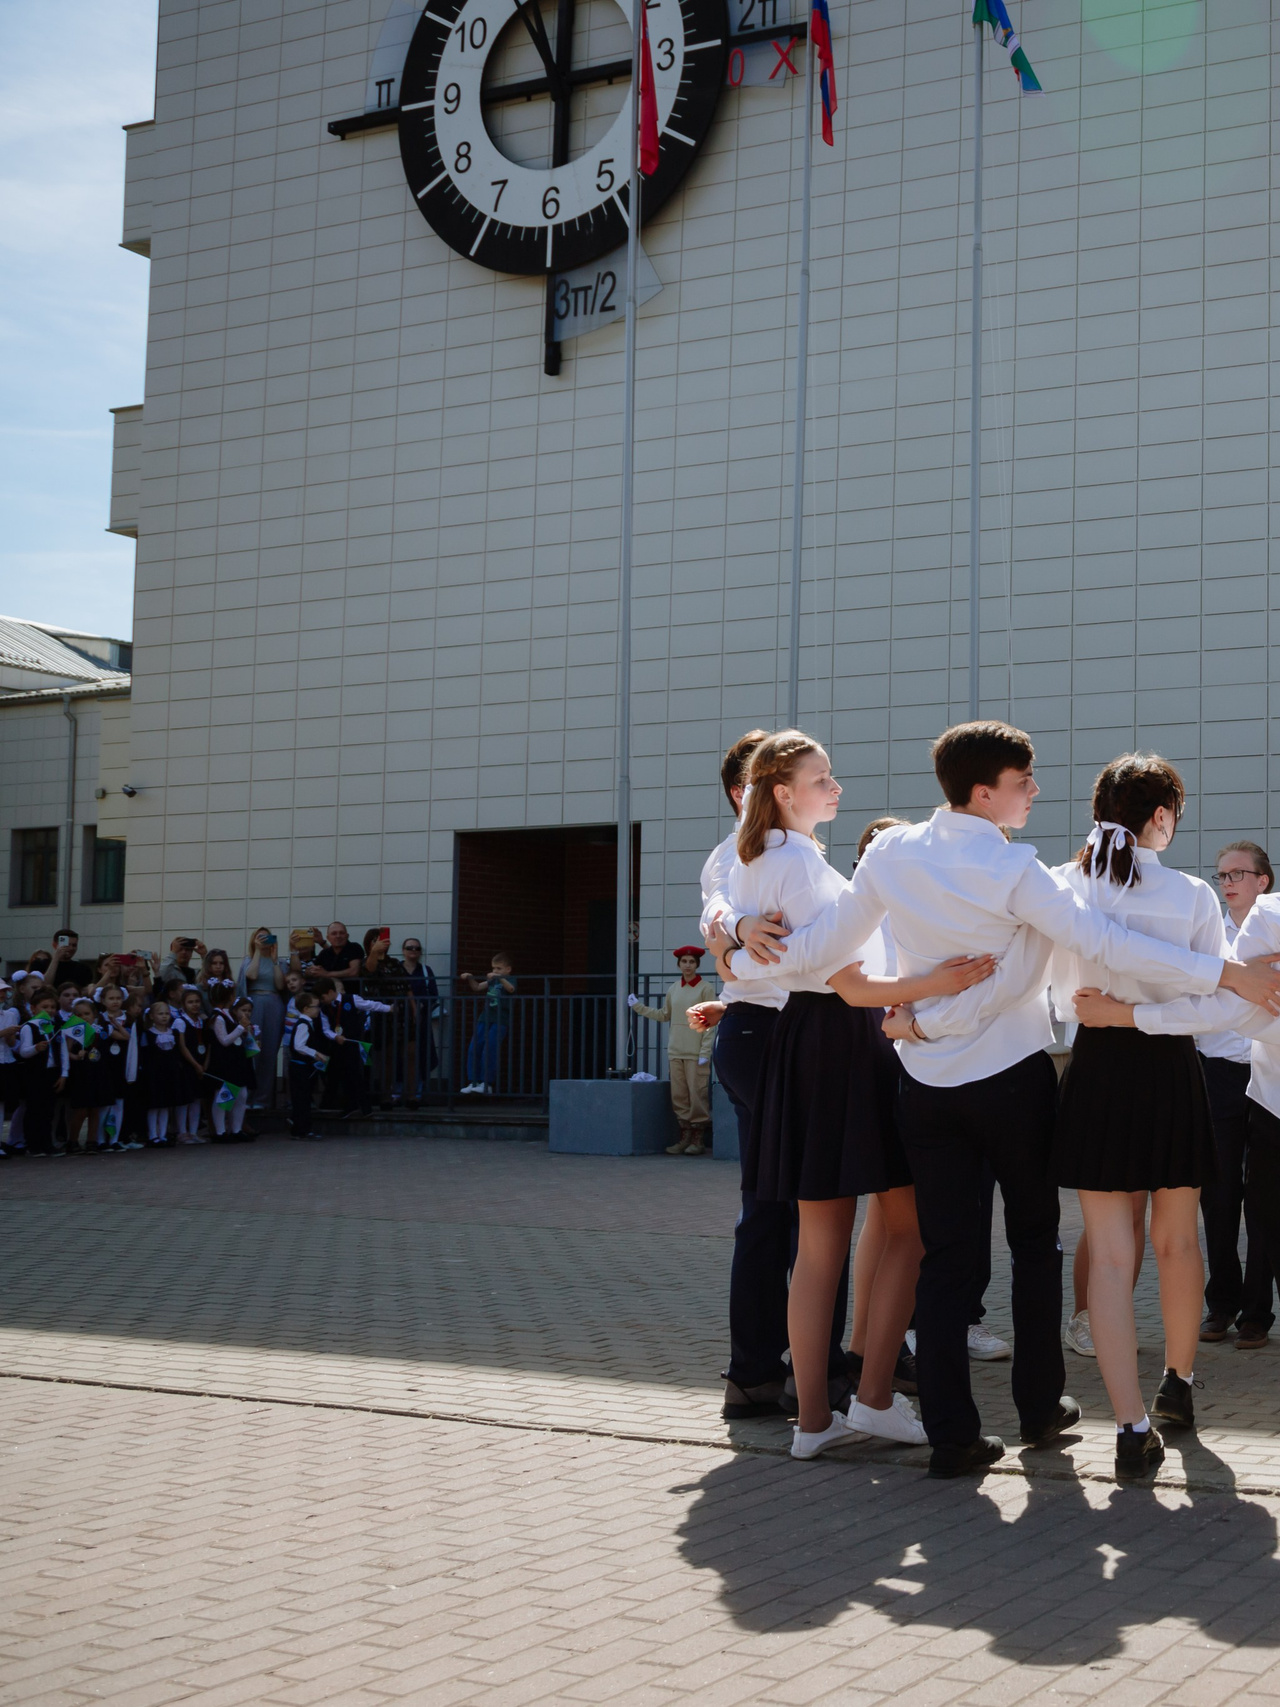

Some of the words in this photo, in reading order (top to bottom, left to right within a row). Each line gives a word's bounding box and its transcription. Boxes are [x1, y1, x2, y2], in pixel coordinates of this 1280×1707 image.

[455, 16, 487, 54] 10
[656, 37, 676, 71] 3
[443, 82, 462, 115] 9
[454, 142, 473, 174] 8
[595, 158, 615, 192] 5
[490, 179, 509, 213] 7
[541, 186, 561, 219] 6
